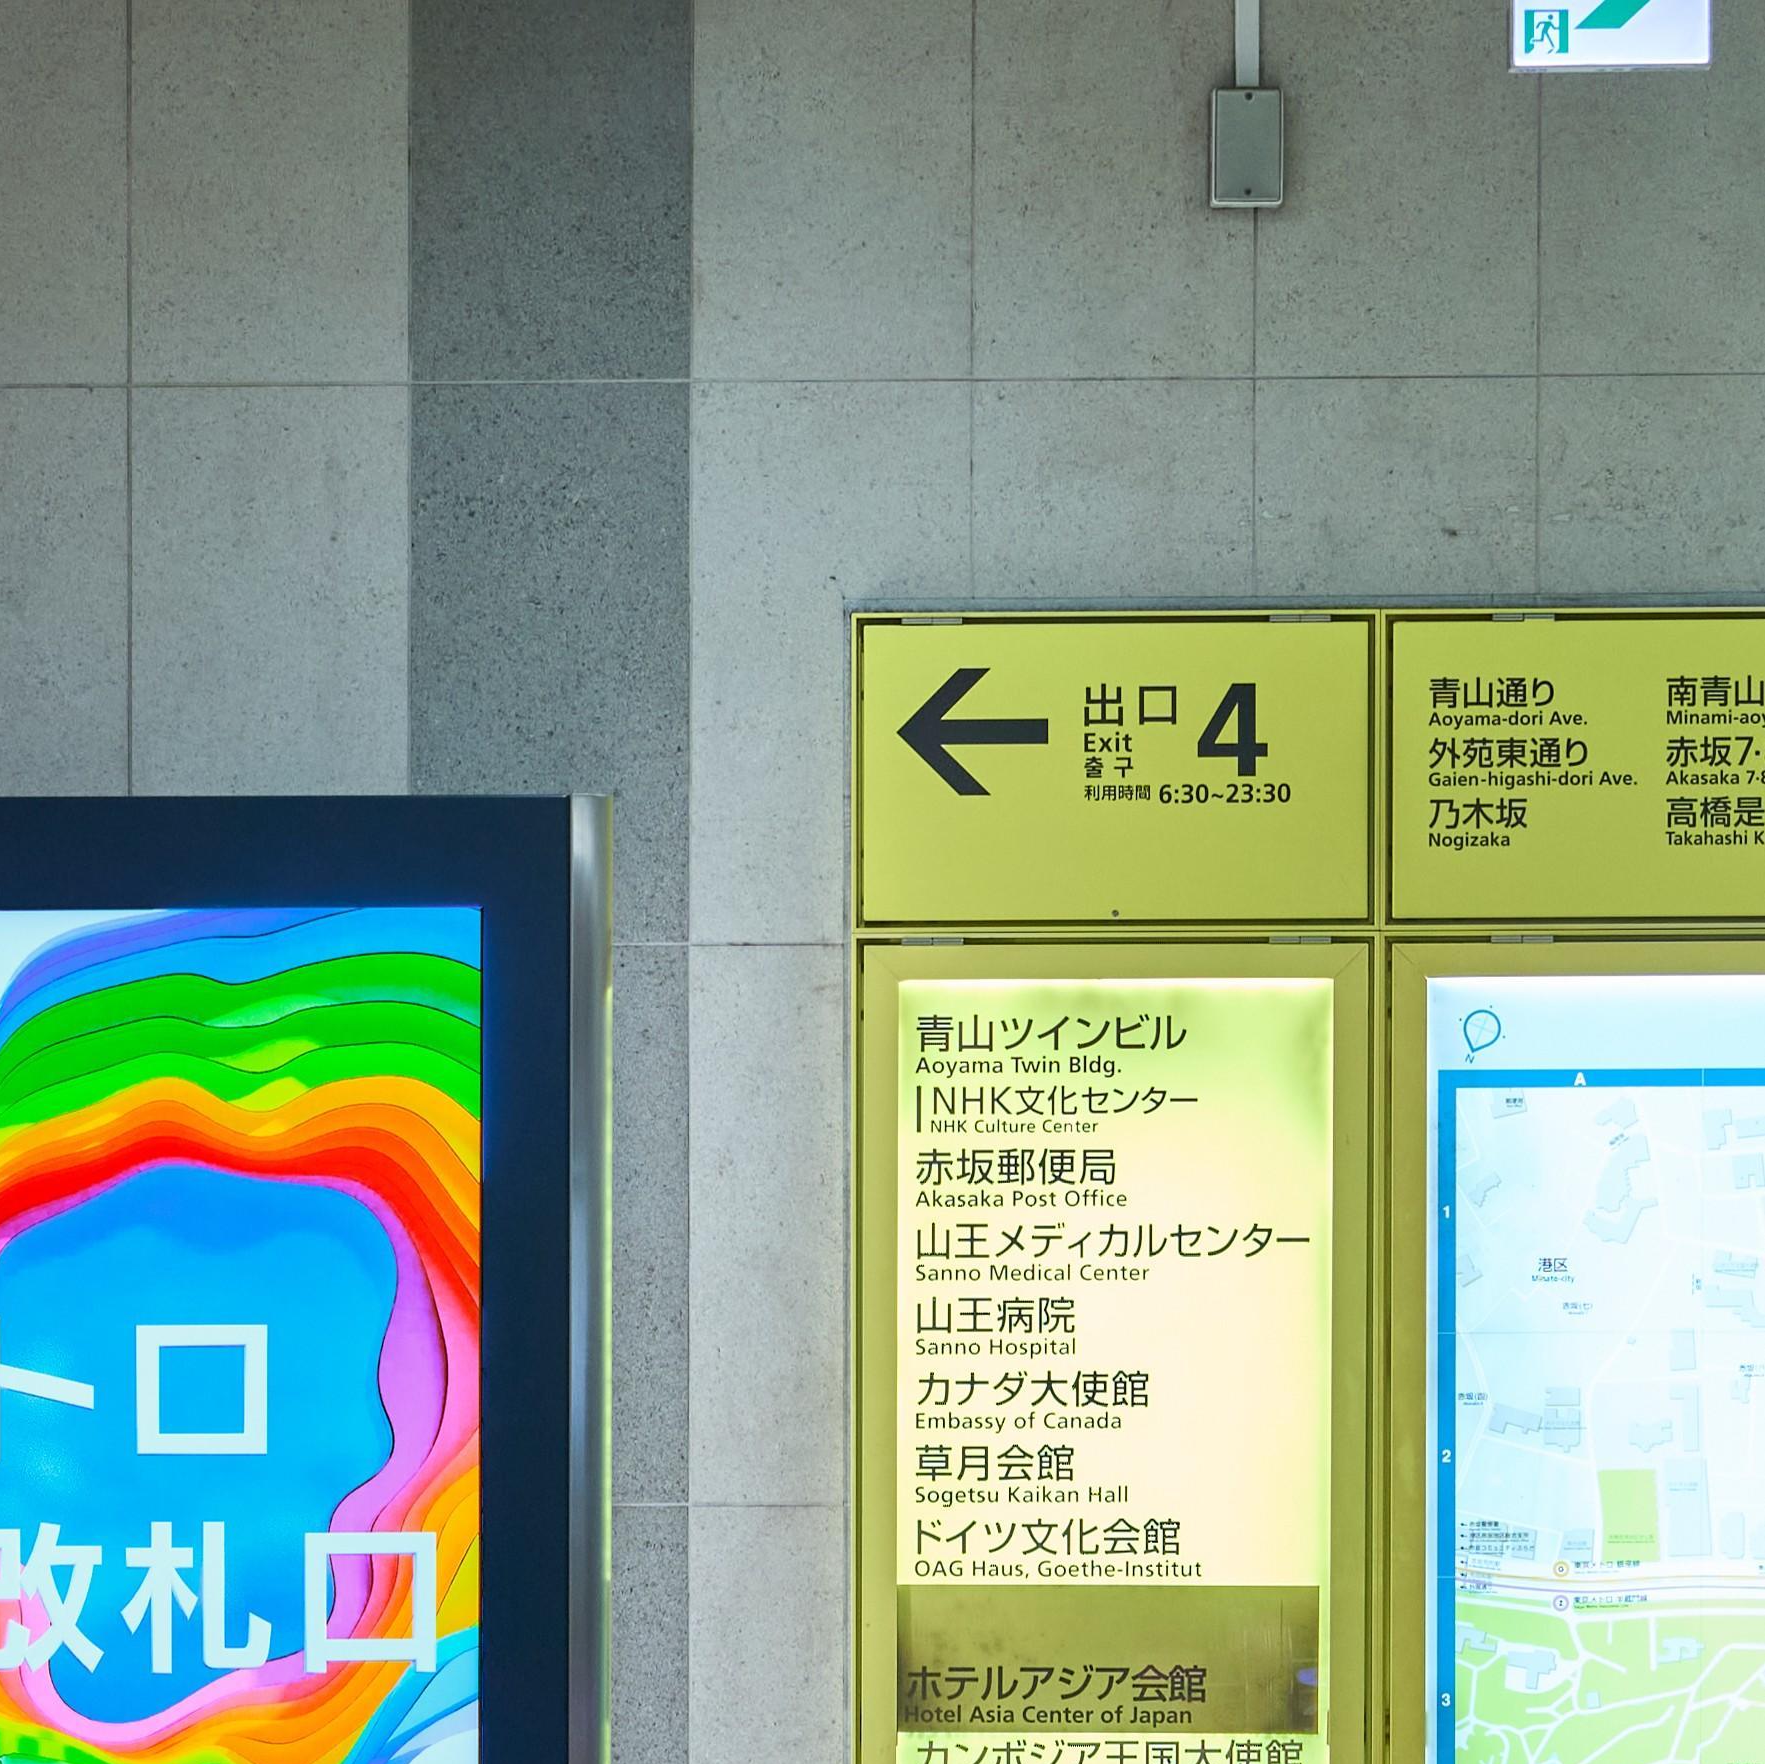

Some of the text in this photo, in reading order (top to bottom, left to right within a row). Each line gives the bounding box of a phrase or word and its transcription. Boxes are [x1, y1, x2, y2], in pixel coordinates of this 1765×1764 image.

[1429, 676, 1555, 709] 青山通り
[1666, 674, 1765, 708] 南青山
[1083, 682, 1177, 727] 出口
[1197, 682, 1269, 777] 4
[1428, 710, 1588, 731] Aoyama-dori Ave.
[1083, 731, 1133, 753] Exit
[1428, 736, 1588, 769] 外苑東通り
[1428, 770, 1638, 791] Gaien-higashi-dori Ave.
[1665, 769, 1740, 786] Akasaka
[1084, 784, 1151, 802] 利用時間
[1428, 797, 1528, 830] 乃木坂
[1665, 795, 1765, 829] 高橋是
[1428, 831, 1511, 851] Nogizaka
[1665, 829, 1748, 846] Takahashi
[916, 1013, 1187, 1053] 青山ツインビル
[915, 1054, 1122, 1079] Aoyama Twin Bldg.
[1573, 1072, 1587, 1086] A
[933, 1086, 1199, 1116] NHK文化センター
[930, 1118, 1099, 1134] NHK Culture Center
[916, 1148, 1116, 1186] 赤坂郵便局
[915, 1188, 1127, 1208] Akasaka Post Office
[1443, 1205, 1450, 1218] 1
[917, 1221, 1311, 1260] 山王メディカルセンター
[915, 1263, 1150, 1282] Sanno Medical Center
[1538, 1258, 1568, 1272] 港区
[916, 1296, 1075, 1334] 山王病院
[915, 1337, 1076, 1360] Sanno Hospital
[917, 1370, 1149, 1408] カナダ大使館
[915, 1411, 1122, 1434] Embassy of Canada
[915, 1444, 1075, 1482] 草月会館
[1442, 1450, 1451, 1462] 2
[915, 1485, 1128, 1508] Sogetsu Kaikan Hall
[917, 1517, 1181, 1556] ドイツ文化会館
[914, 1559, 1202, 1579] OAG Haus, Goethe-Institut
[907, 1664, 1208, 1704] ホテルアジア会館
[1441, 1694, 1450, 1706] 3
[904, 1706, 1192, 1726] Hotel Asia Center of Japan
